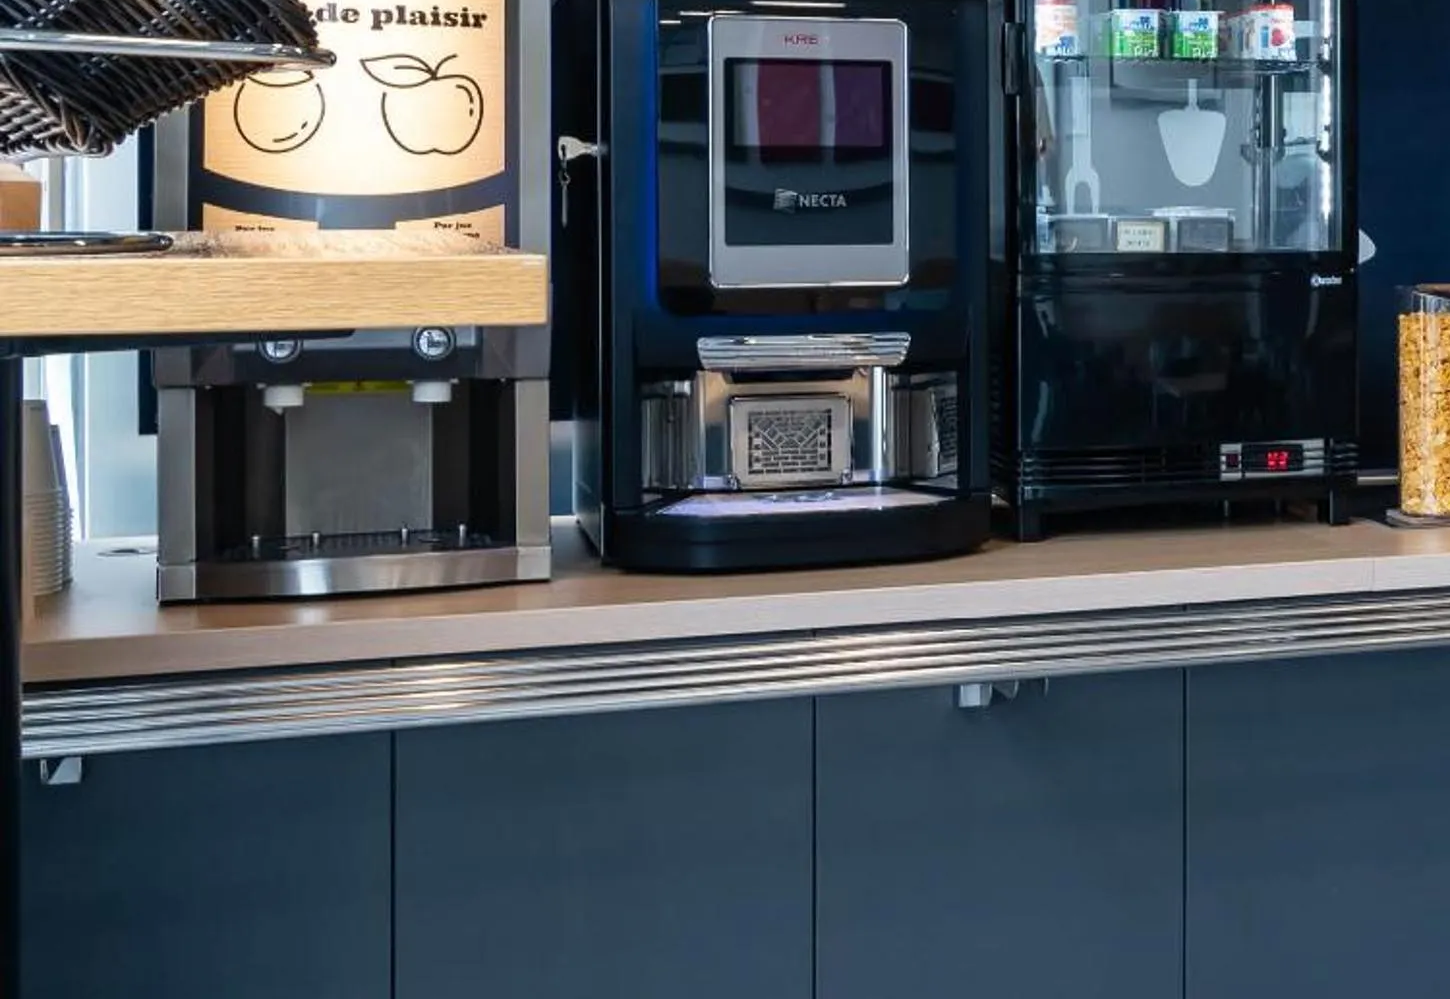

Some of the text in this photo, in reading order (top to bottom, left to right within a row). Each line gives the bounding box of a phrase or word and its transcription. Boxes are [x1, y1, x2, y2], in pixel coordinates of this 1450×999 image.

[316, 3, 487, 31] de plaisir
[799, 194, 847, 208] NECTA
